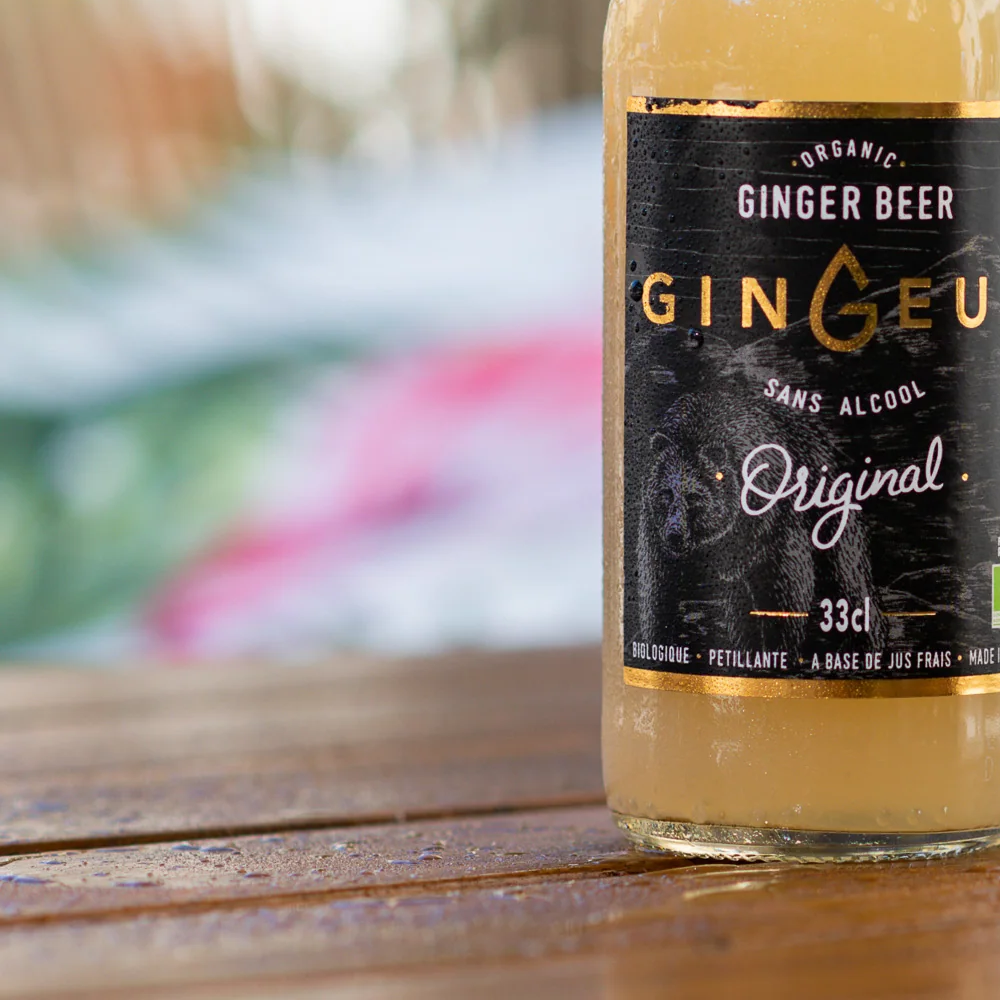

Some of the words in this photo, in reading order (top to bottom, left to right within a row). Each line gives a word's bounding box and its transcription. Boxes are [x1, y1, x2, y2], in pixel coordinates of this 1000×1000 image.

[800, 138, 898, 169] ORGANIC
[738, 184, 861, 220] GINGER
[875, 185, 954, 220] BEER
[763, 378, 821, 413] SANS
[839, 379, 926, 416] ALCOOL
[740, 435, 944, 550] Original
[818, 597, 870, 632] 33cl
[632, 641, 690, 664] BIOLOGIQUE
[708, 648, 788, 669] PETILLANTE
[811, 652, 820, 669] A
[825, 652, 859, 669] BASE
[865, 652, 881, 669] DE
[887, 651, 912, 669] JUS
[916, 650, 952, 668] FRAIS
[969, 646, 995, 666] MADE
